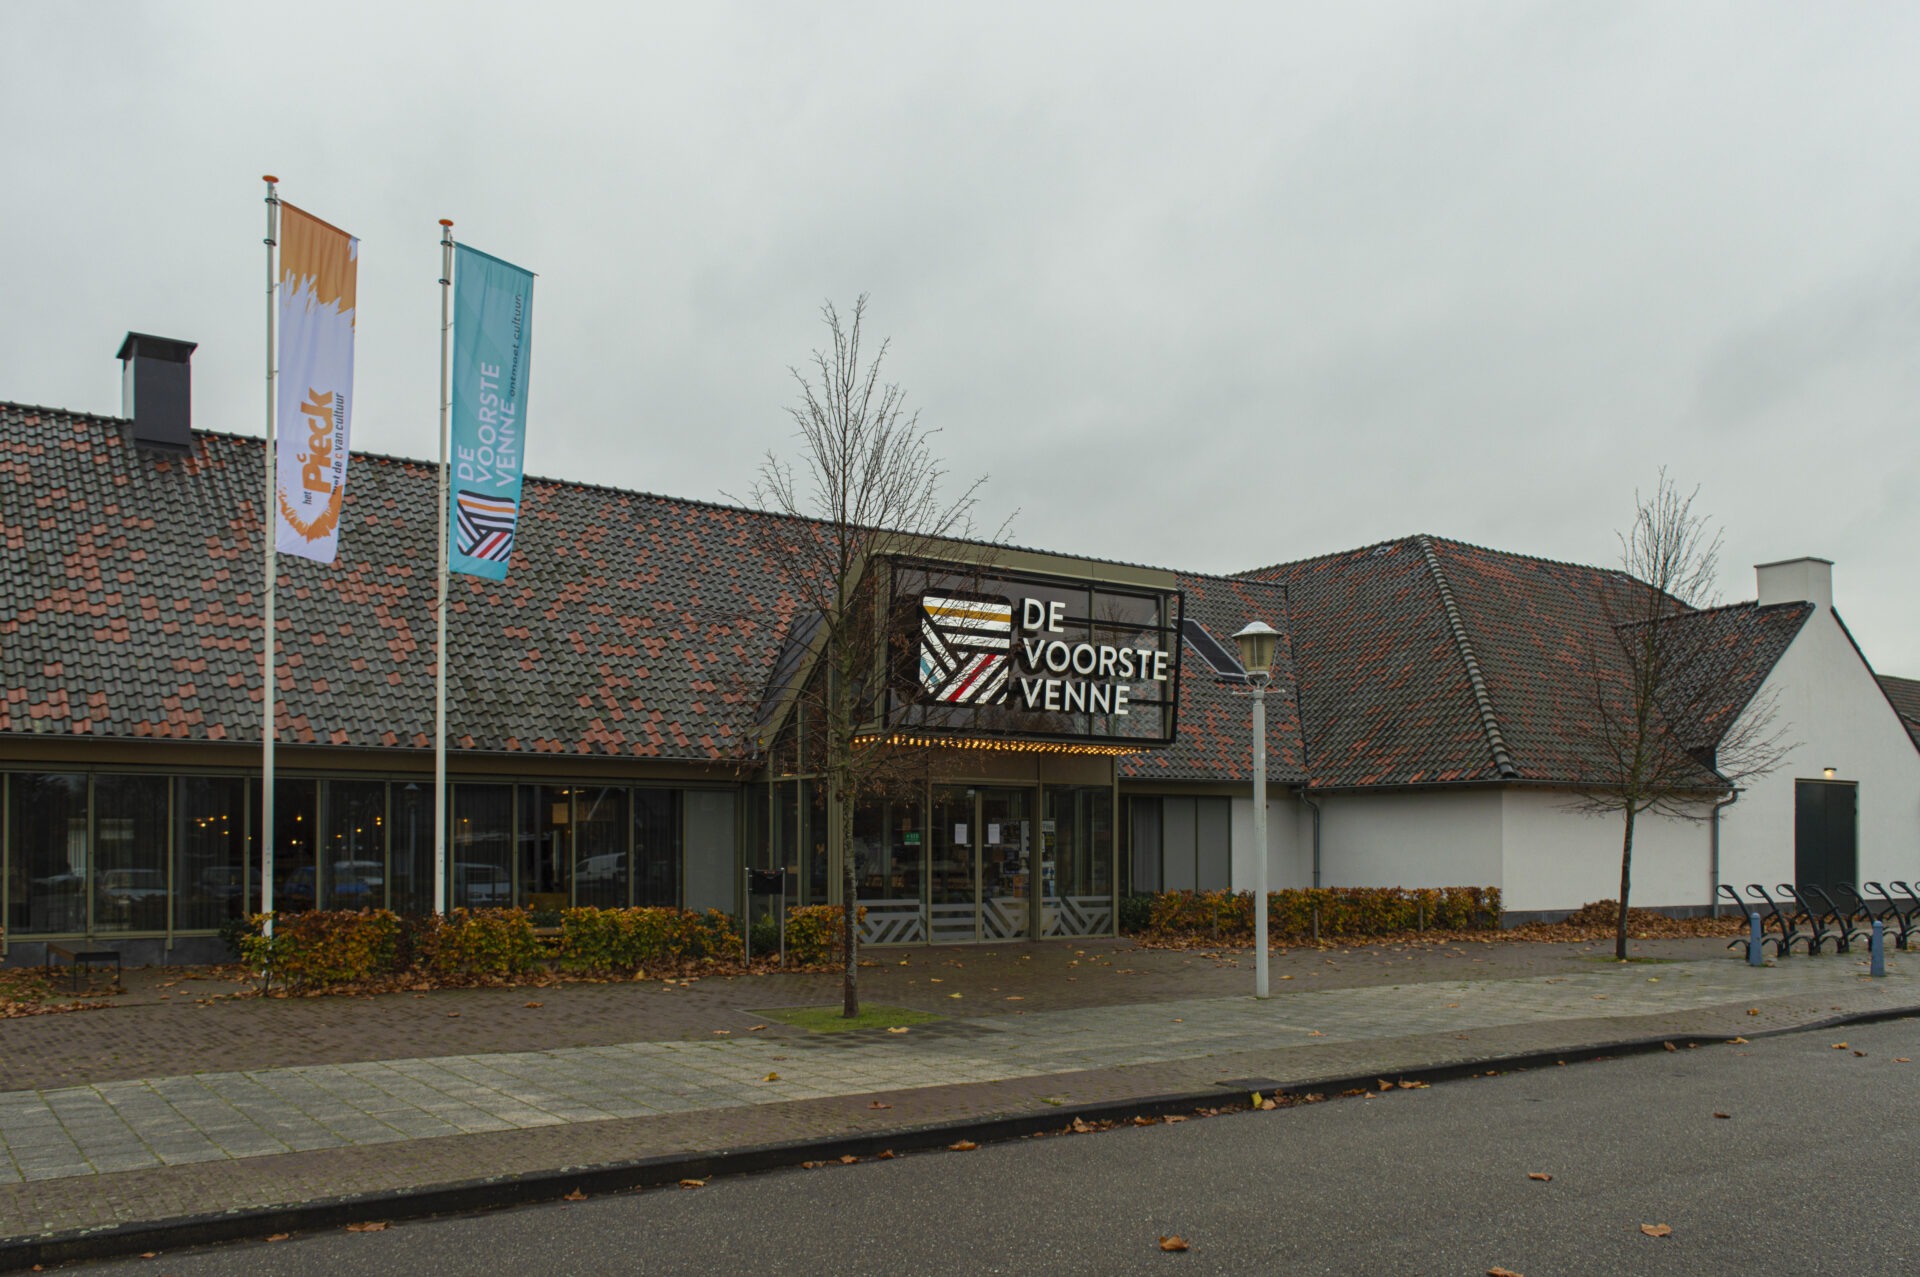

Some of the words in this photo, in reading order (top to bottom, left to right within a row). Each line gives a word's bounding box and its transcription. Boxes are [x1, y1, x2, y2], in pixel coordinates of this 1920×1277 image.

[510, 343, 520, 398] ontmoet
[333, 393, 344, 430] cultuur
[476, 362, 500, 483] VOORSTE
[297, 387, 334, 494] Pieck
[334, 432, 343, 452] van
[496, 398, 516, 487] VENNE
[332, 461, 342, 475] de
[457, 445, 475, 481] DE
[302, 491, 312, 505] het
[1023, 598, 1066, 633] DE
[1023, 637, 1169, 681] VOORSTE
[1021, 677, 1131, 715] VENNE
